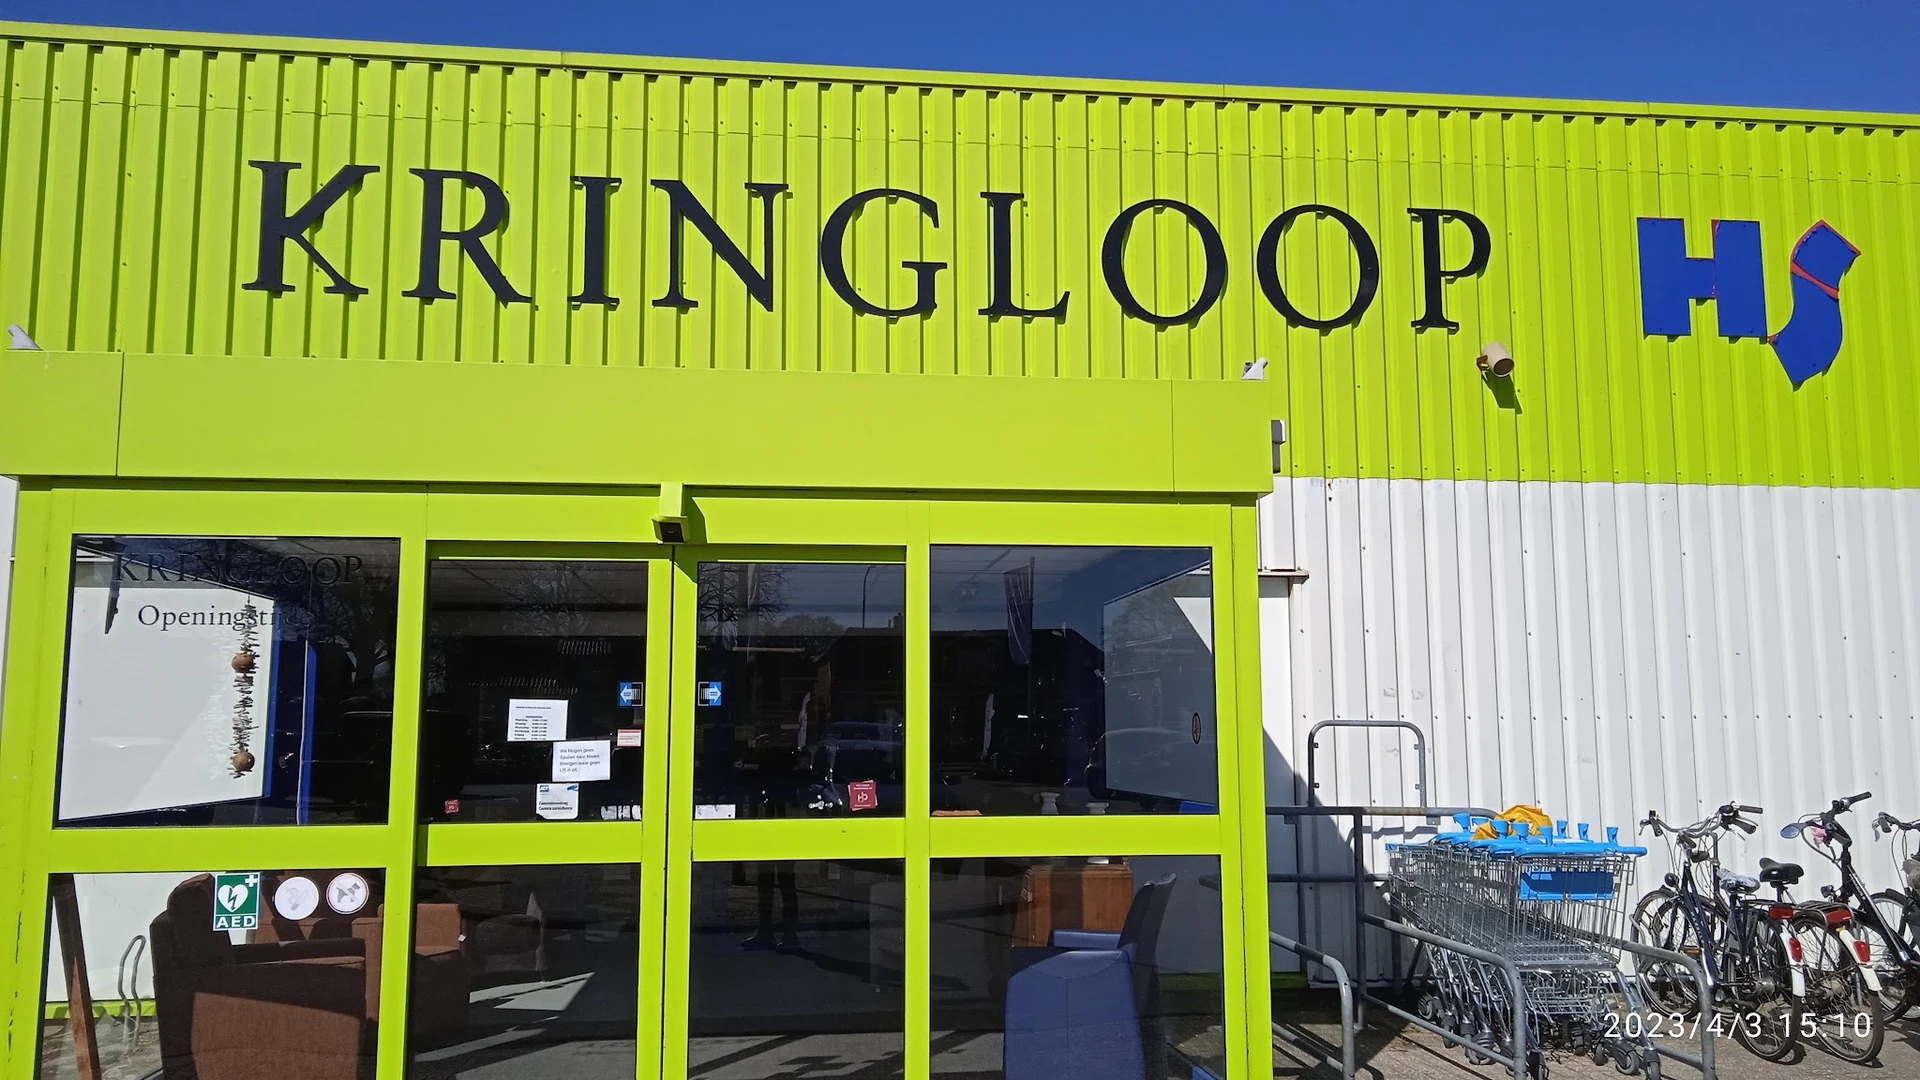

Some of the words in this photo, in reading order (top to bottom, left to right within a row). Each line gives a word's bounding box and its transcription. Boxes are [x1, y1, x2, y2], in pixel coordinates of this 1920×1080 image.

[242, 160, 1492, 331] KRINGLOOP
[1636, 217, 1861, 386] HS
[113, 552, 363, 585] KRINGLOOP
[216, 915, 256, 928] AED
